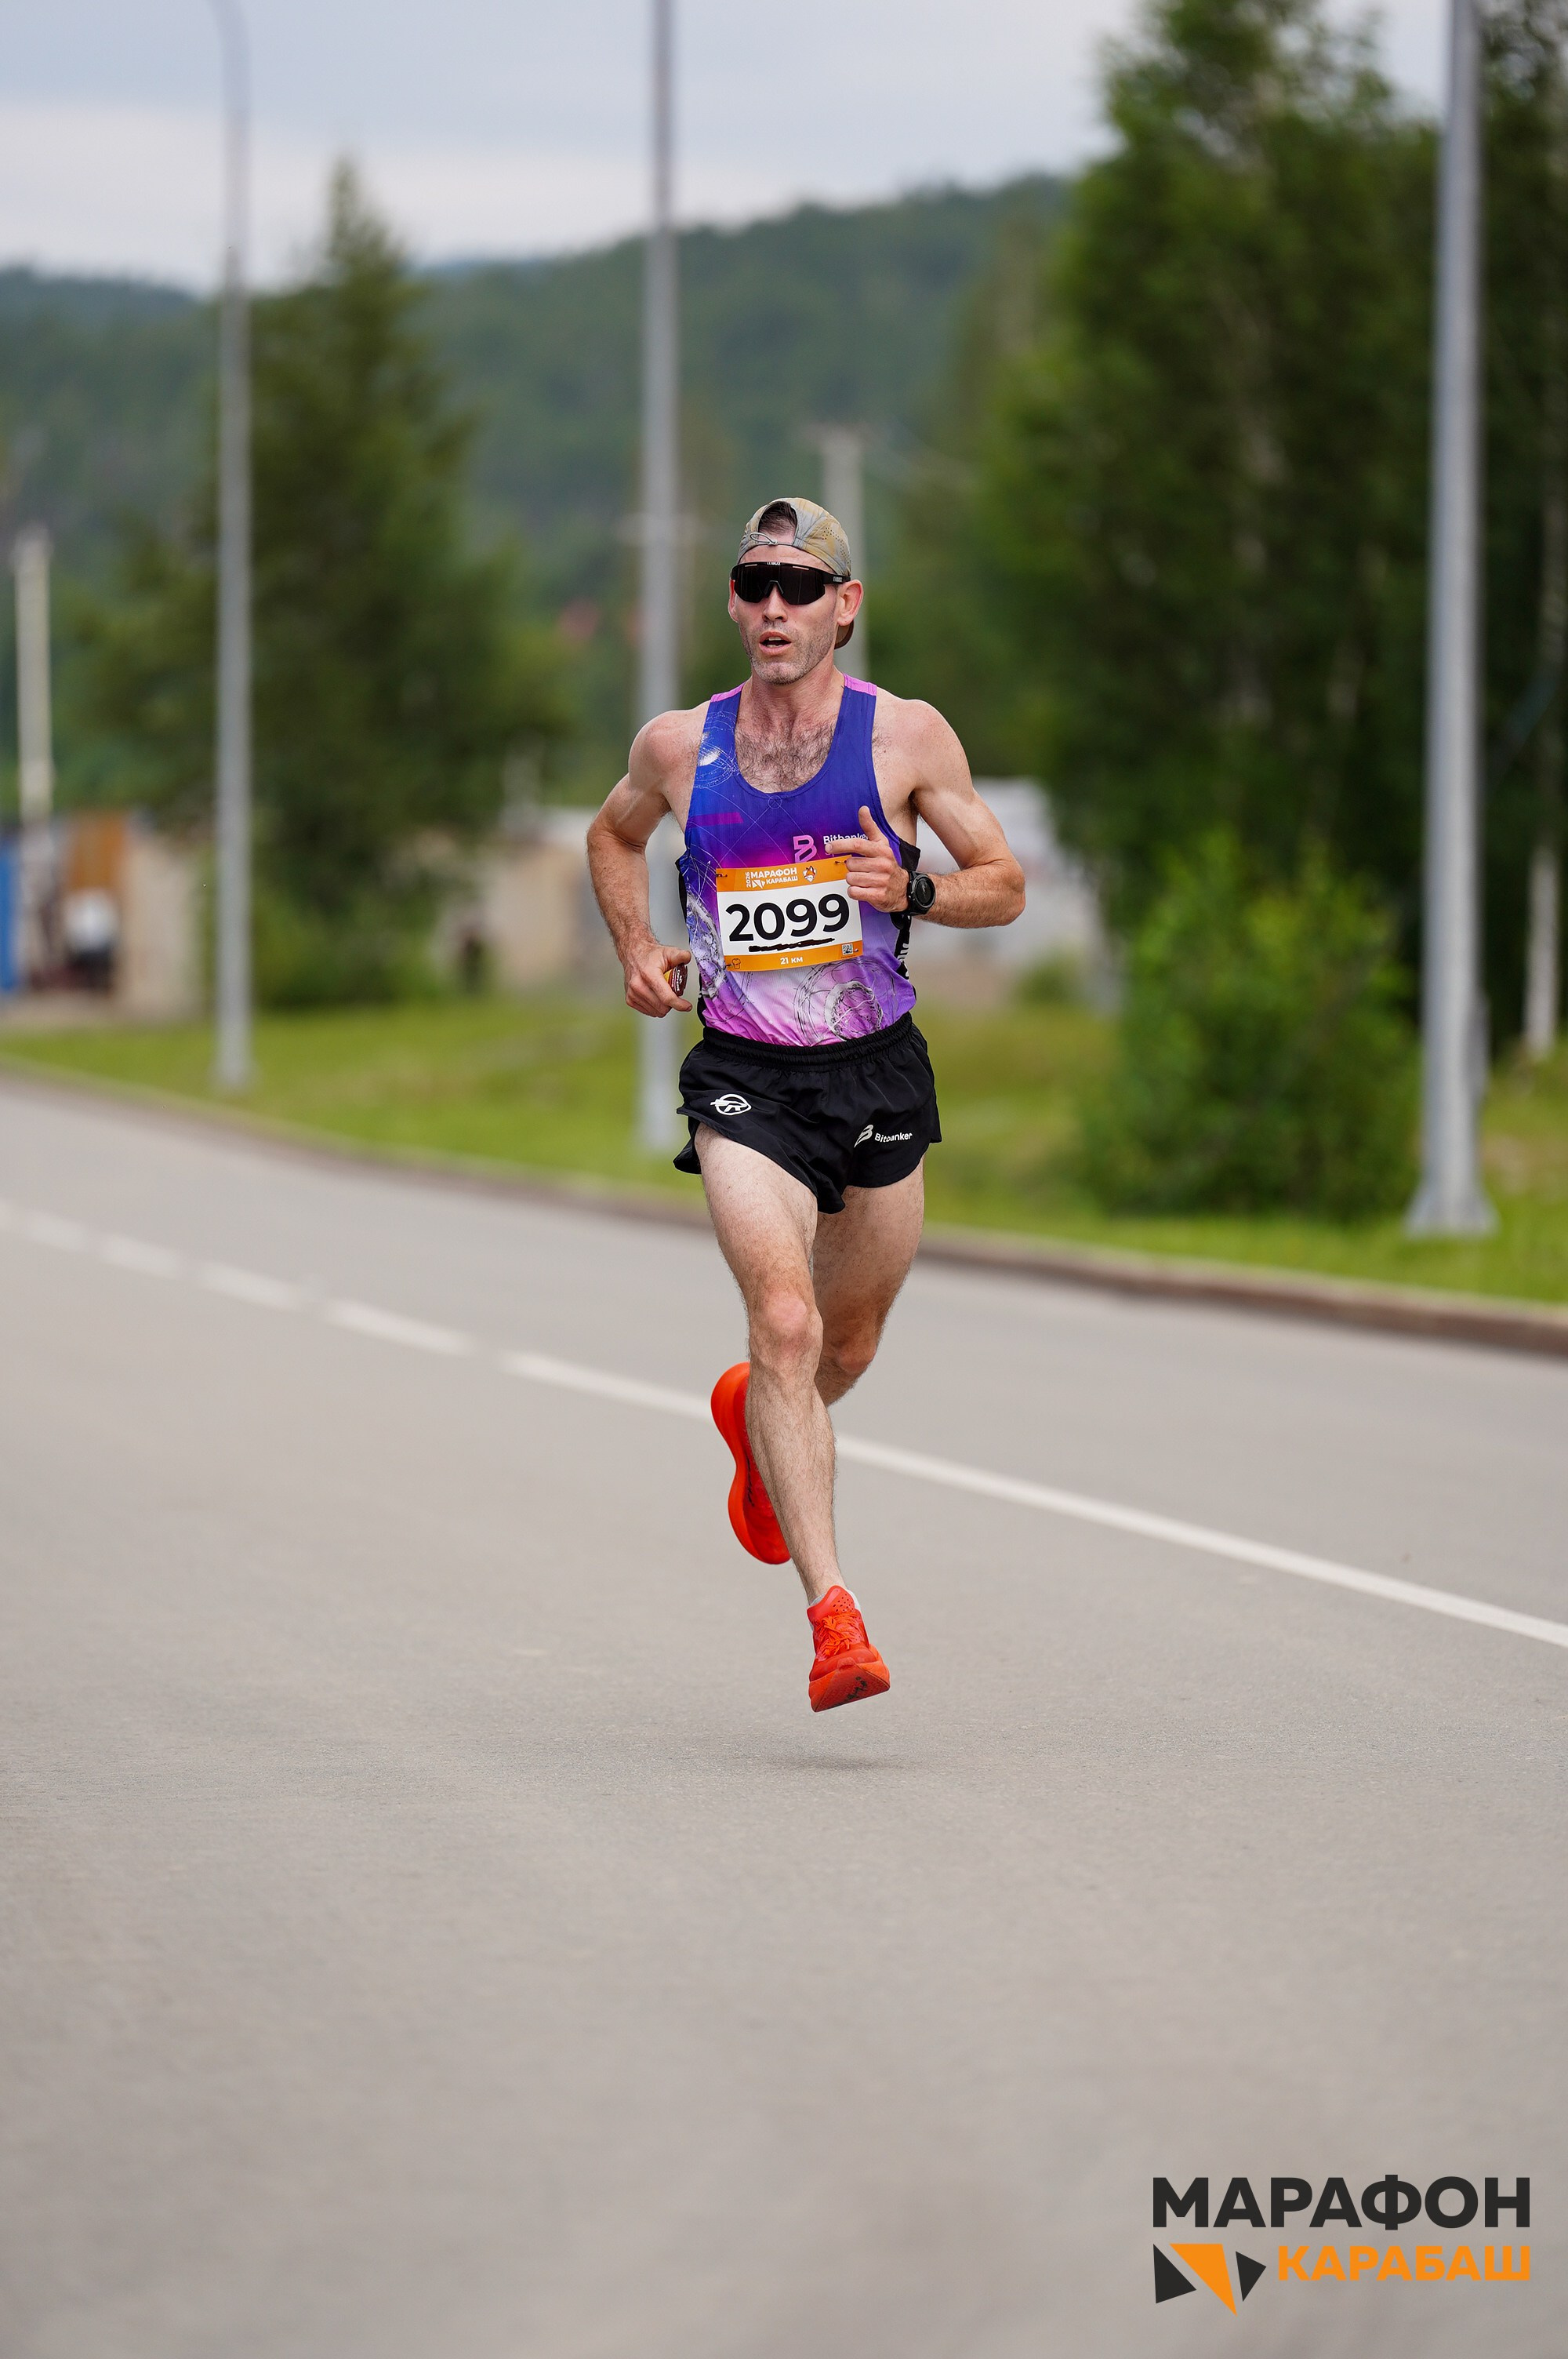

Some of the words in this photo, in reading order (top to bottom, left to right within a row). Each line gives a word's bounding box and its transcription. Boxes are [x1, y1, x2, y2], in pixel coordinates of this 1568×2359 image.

[750, 867, 797, 879] МАРАФОН
[766, 875, 798, 885] КАРАБАШ
[725, 893, 850, 941] 2099
